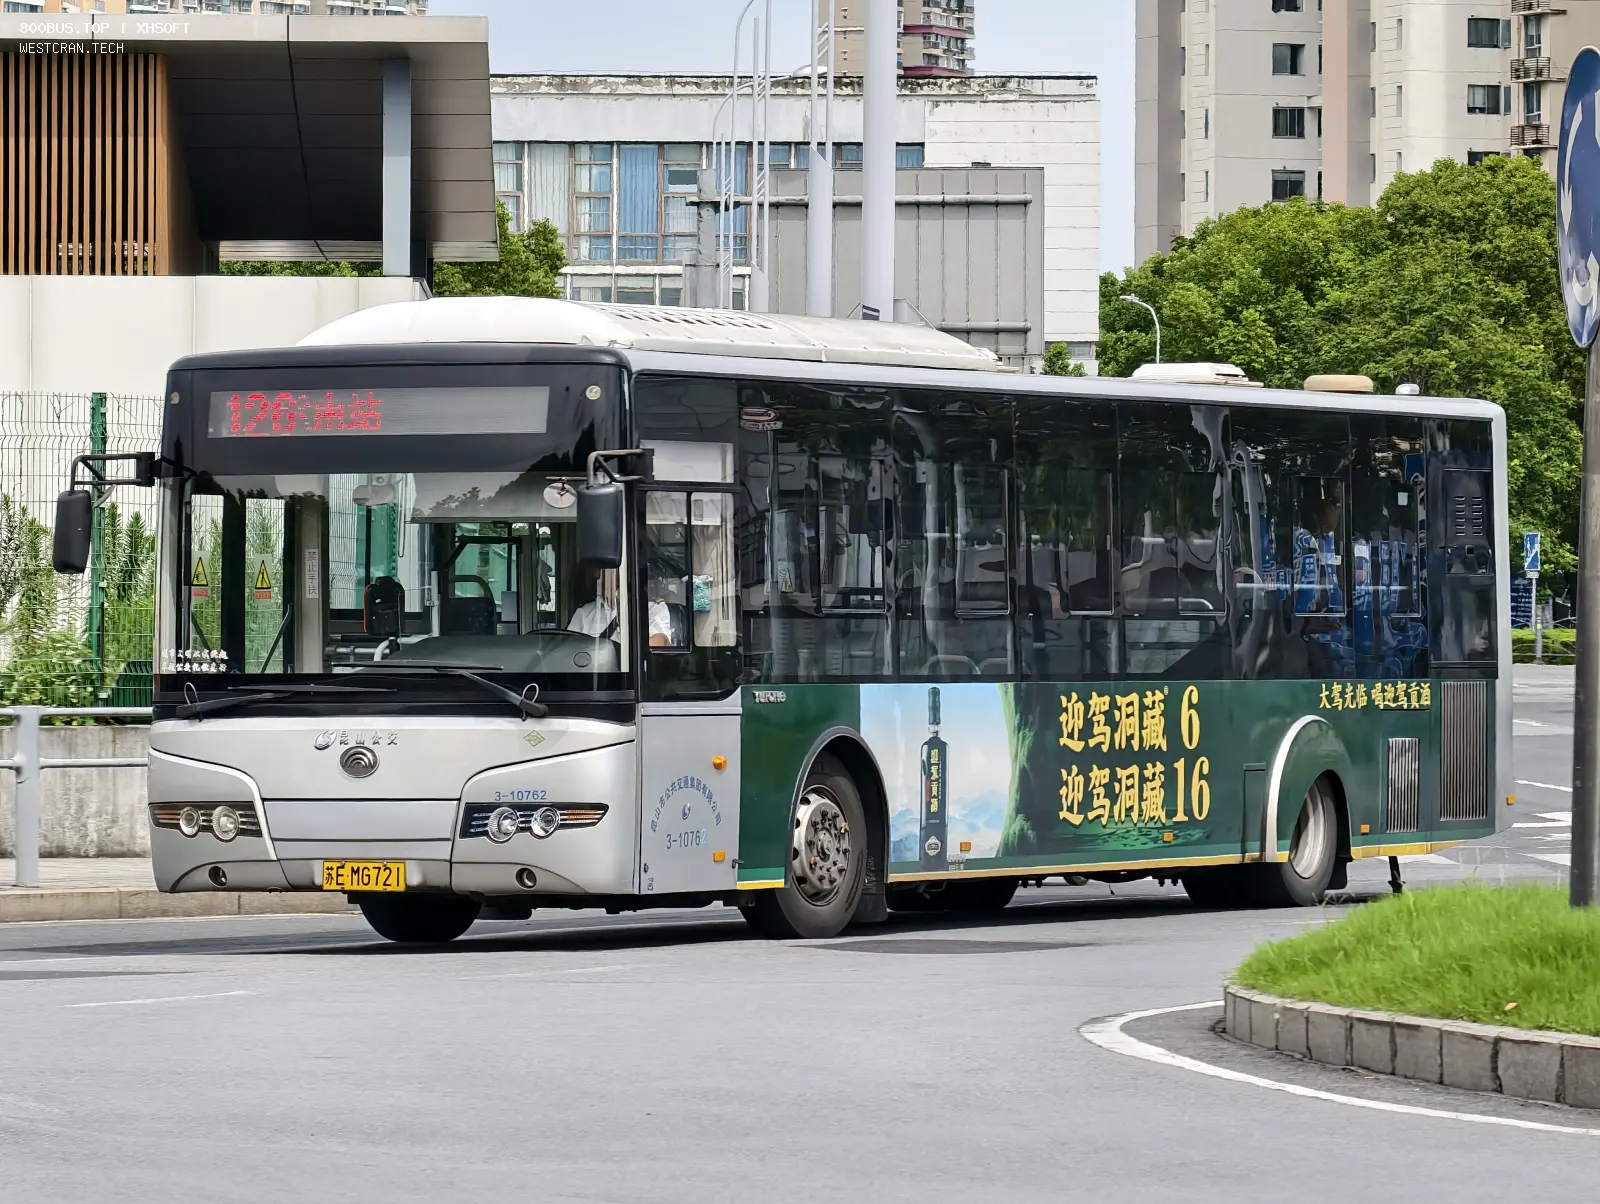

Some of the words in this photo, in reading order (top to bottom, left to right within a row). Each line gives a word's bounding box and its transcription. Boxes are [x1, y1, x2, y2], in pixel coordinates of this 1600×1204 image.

[307, 551, 318, 595] 禁止手扶
[1319, 681, 1368, 711] 大驾光临
[1371, 681, 1431, 710] 喝迎驾贡酒
[1059, 690, 1168, 753] 迎驾洞藏
[1180, 685, 1200, 751] 6
[339, 729, 398, 746] 昆山公交
[494, 789, 548, 802] 3-10762
[666, 827, 708, 850] 3-10762
